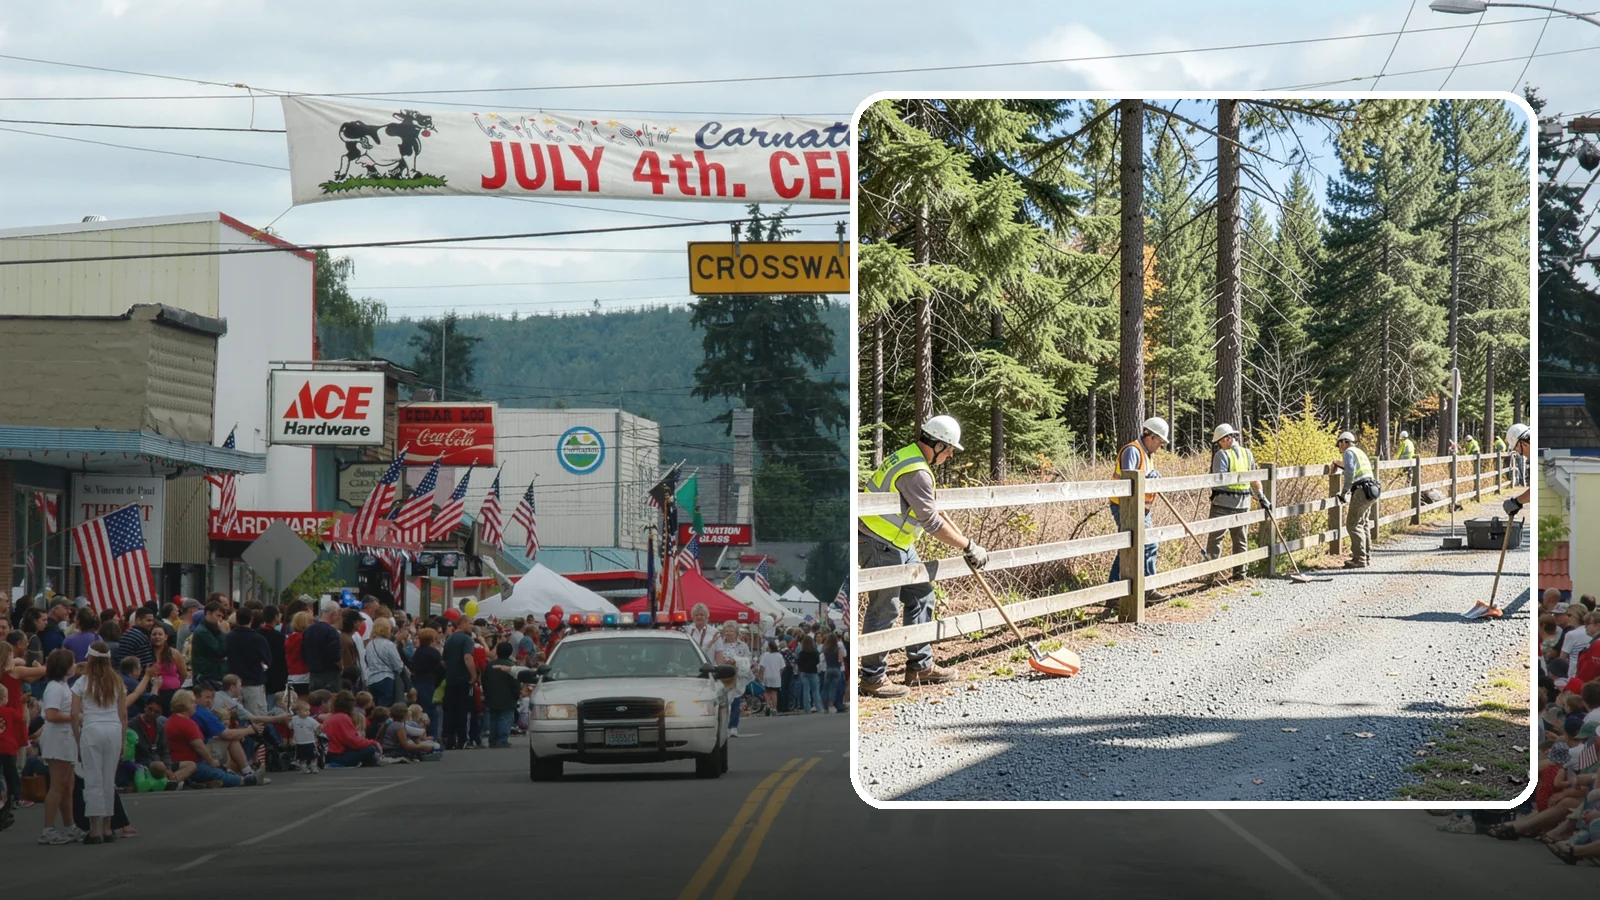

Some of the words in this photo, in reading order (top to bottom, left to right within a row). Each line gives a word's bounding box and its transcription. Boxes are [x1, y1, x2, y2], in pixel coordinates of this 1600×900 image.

[481, 140, 605, 192] JULY
[632, 150, 747, 198] 4th.
[696, 254, 850, 281] CROSSWA
[283, 380, 374, 420] ACE
[405, 409, 453, 422] CEDAR
[283, 421, 371, 436] Hardware
[416, 427, 477, 447] Coca-Cola
[95, 485, 125, 495] Vincent
[126, 486, 136, 495] de
[137, 486, 155, 495] Paul
[688, 526, 742, 535] CRNATION
[699, 535, 730, 543] GLASS
